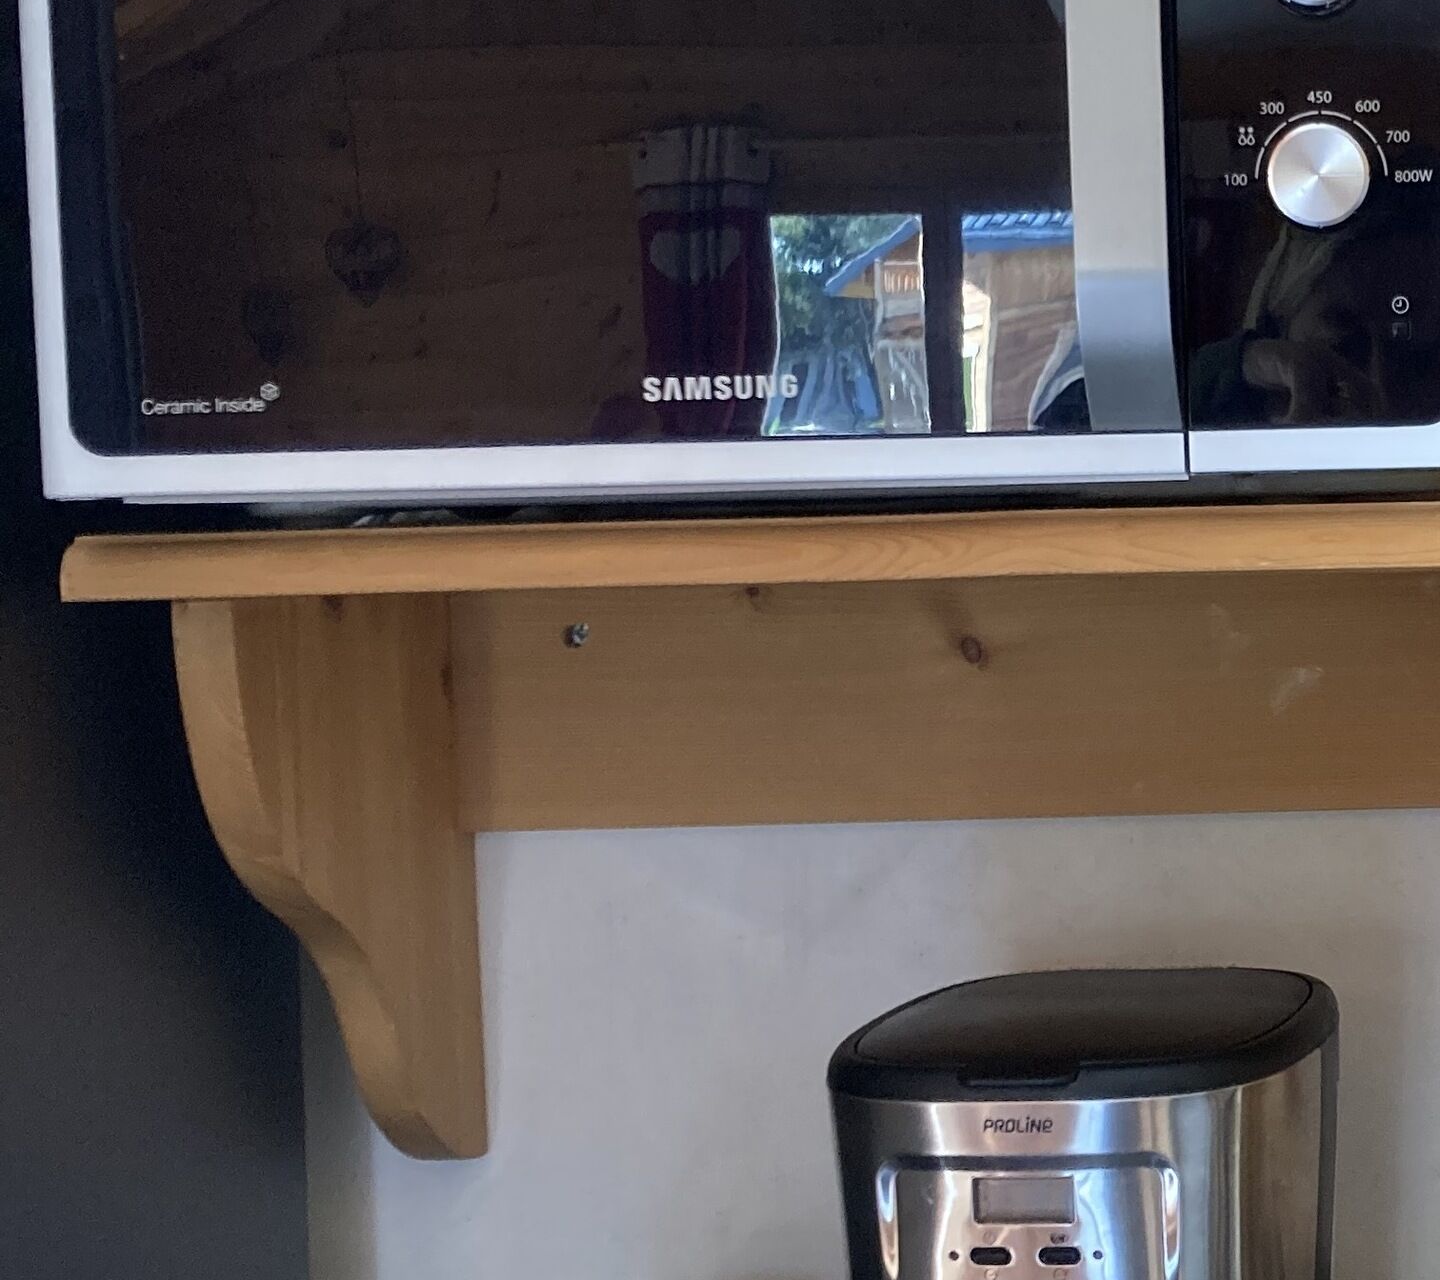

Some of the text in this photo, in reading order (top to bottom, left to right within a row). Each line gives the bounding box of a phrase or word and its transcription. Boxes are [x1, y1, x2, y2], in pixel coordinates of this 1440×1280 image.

[1307, 90, 1332, 104] 450
[1260, 102, 1285, 115] 300
[1355, 100, 1380, 113] 600
[1386, 130, 1410, 143] 700
[1223, 173, 1247, 186] 100
[1394, 170, 1433, 183] 800W
[642, 374, 799, 402] SAMSUNG
[140, 397, 266, 415] Ceramic Inside
